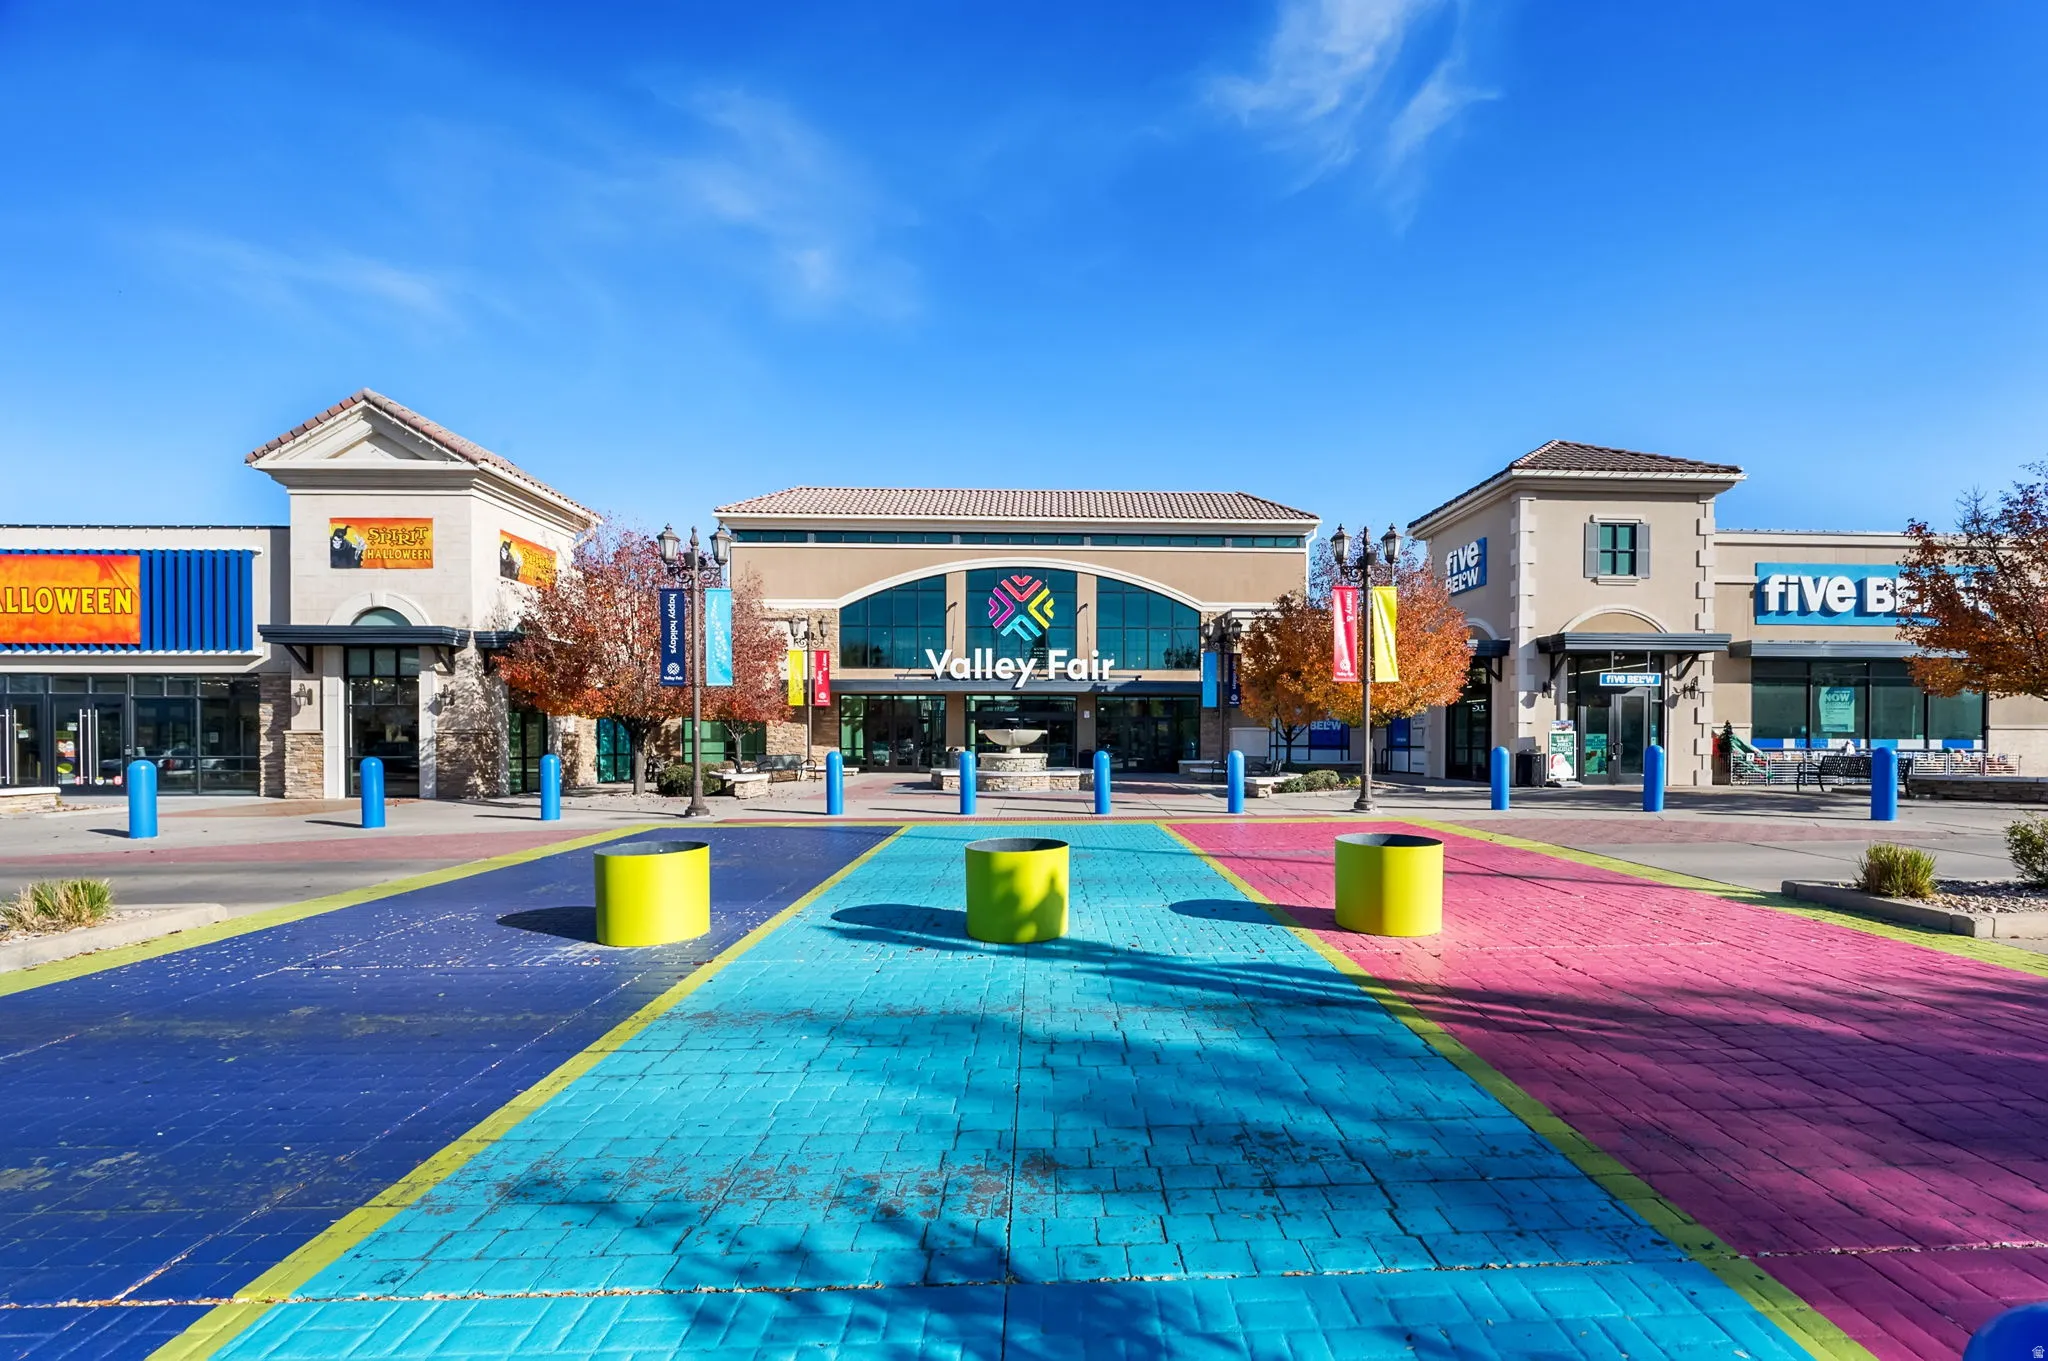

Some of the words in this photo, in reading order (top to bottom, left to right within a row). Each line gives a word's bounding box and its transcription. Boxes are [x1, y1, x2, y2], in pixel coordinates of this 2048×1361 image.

[367, 527, 428, 546] SPIRIT
[367, 549, 431, 560] HALLOWEEN
[1445, 541, 1479, 576] five
[1445, 566, 1479, 595] BELOW
[1761, 574, 1857, 613] five
[0, 586, 133, 614] LLOWEEN
[668, 593, 678, 619] happy
[669, 620, 679, 654] holidays
[925, 648, 1038, 688] Valley
[1048, 649, 1115, 680] Fair
[1606, 675, 1626, 684] five
[1627, 675, 1655, 684] BELOW
[1824, 694, 1850, 702] NOW
[1310, 720, 1342, 730] BELOW
